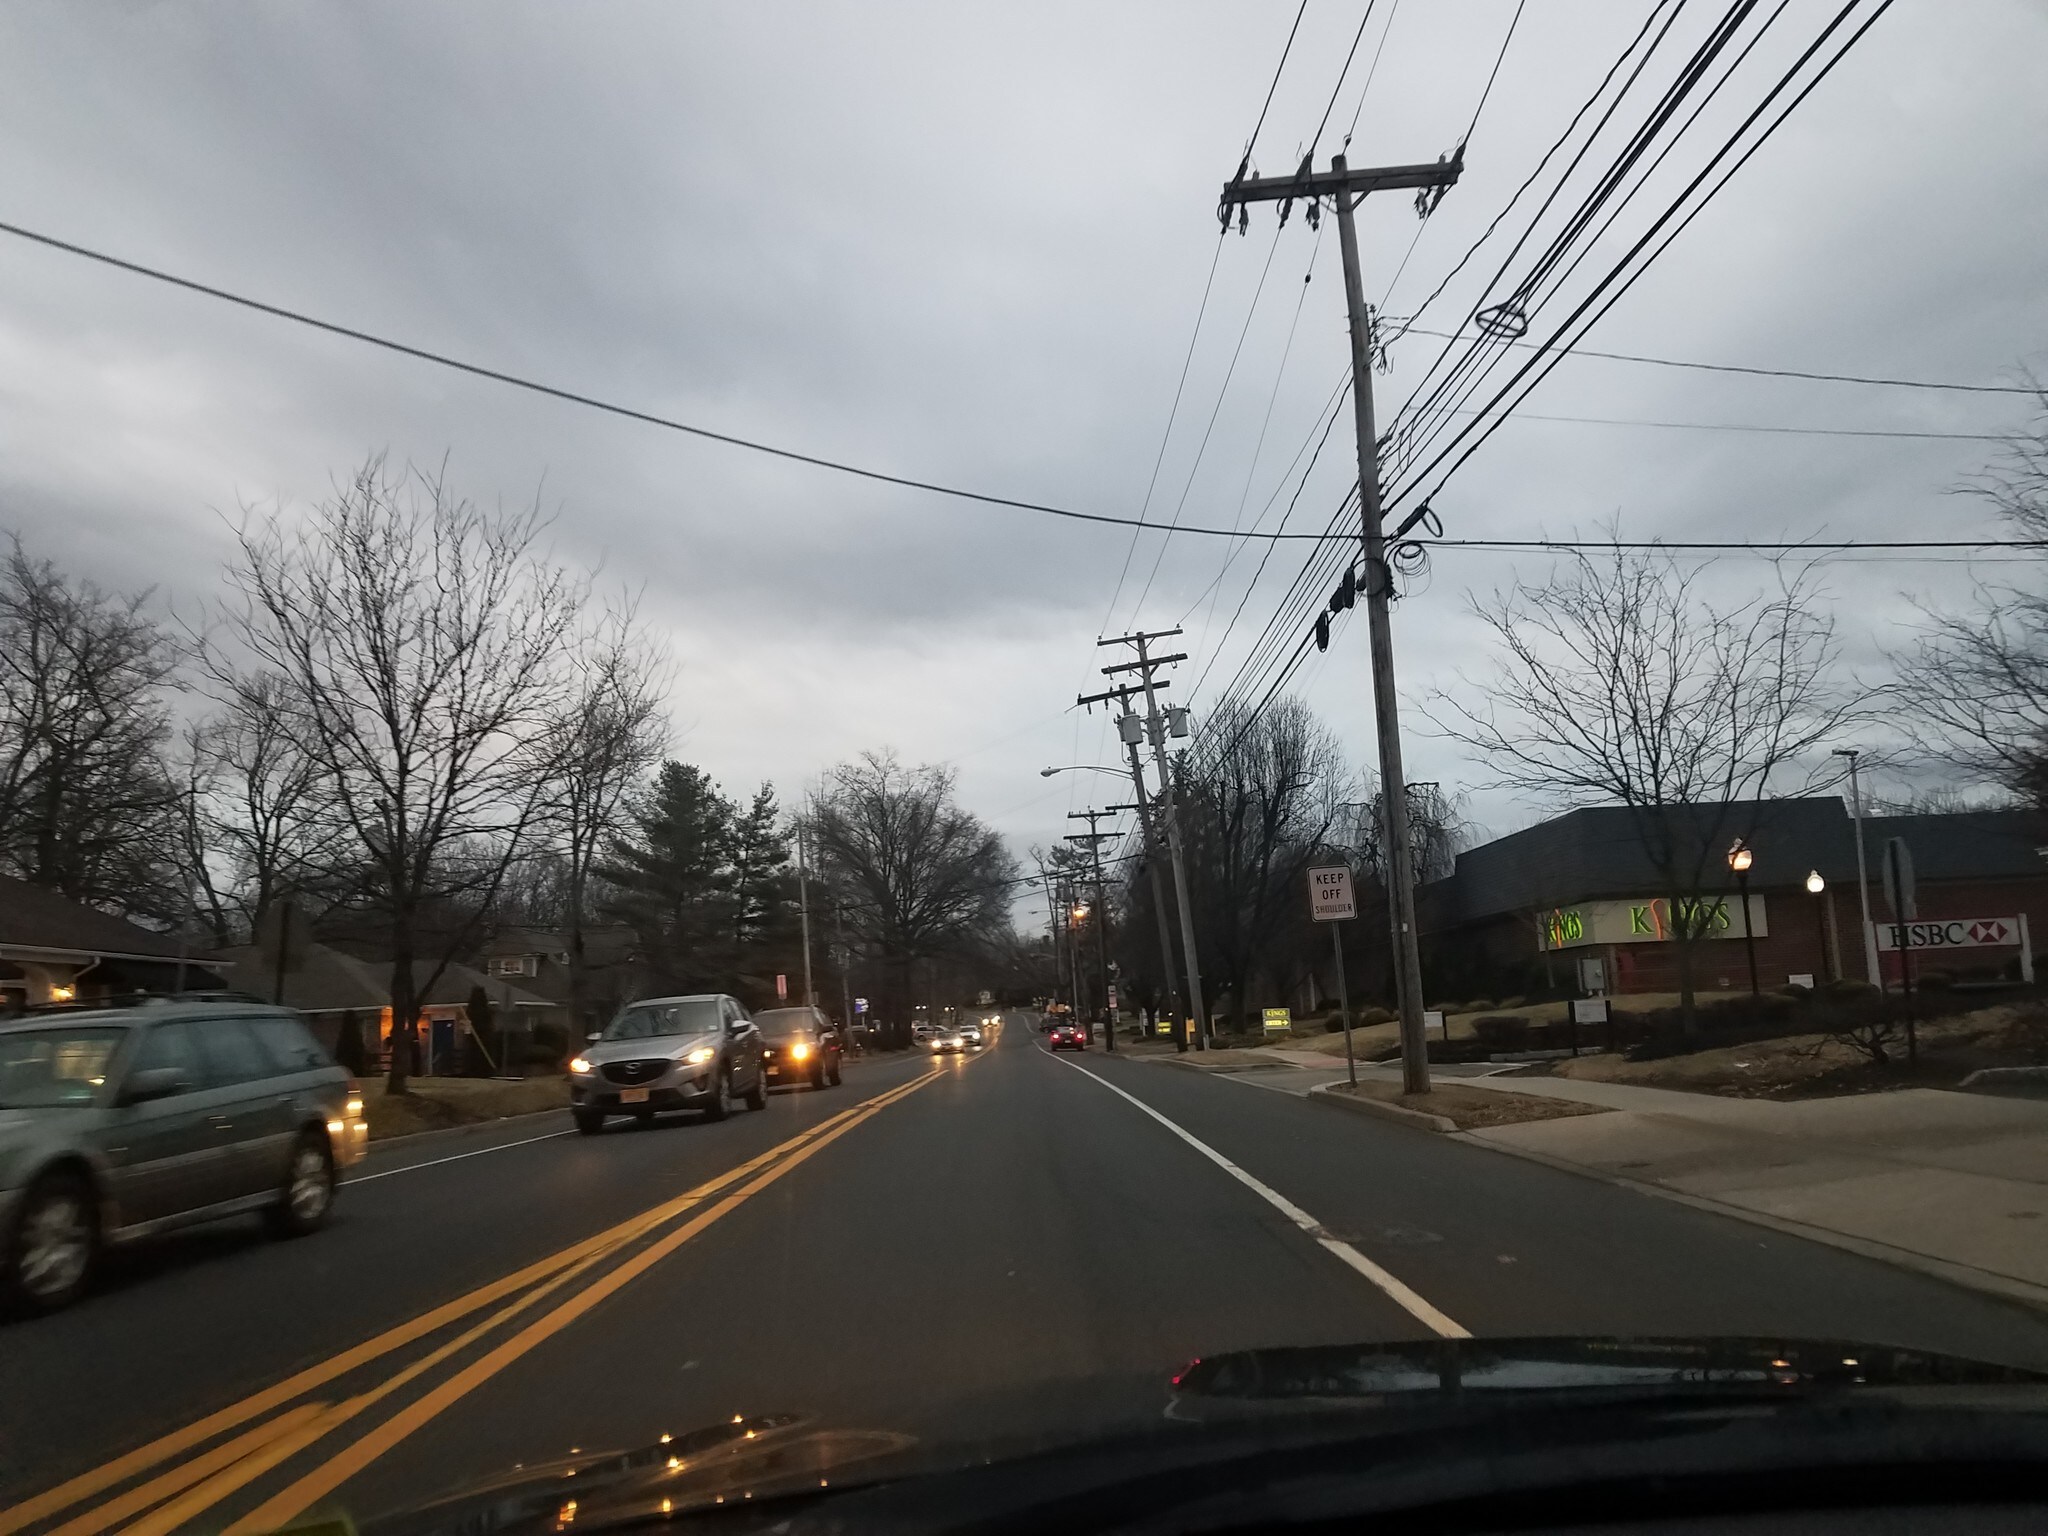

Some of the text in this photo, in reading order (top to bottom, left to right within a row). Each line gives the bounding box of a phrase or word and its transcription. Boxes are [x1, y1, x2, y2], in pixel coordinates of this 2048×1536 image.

[1316, 873, 1344, 885] KEEP
[1322, 889, 1341, 900] OFF
[1315, 903, 1352, 914] SHOULDER
[1889, 922, 1964, 947] HSBC
